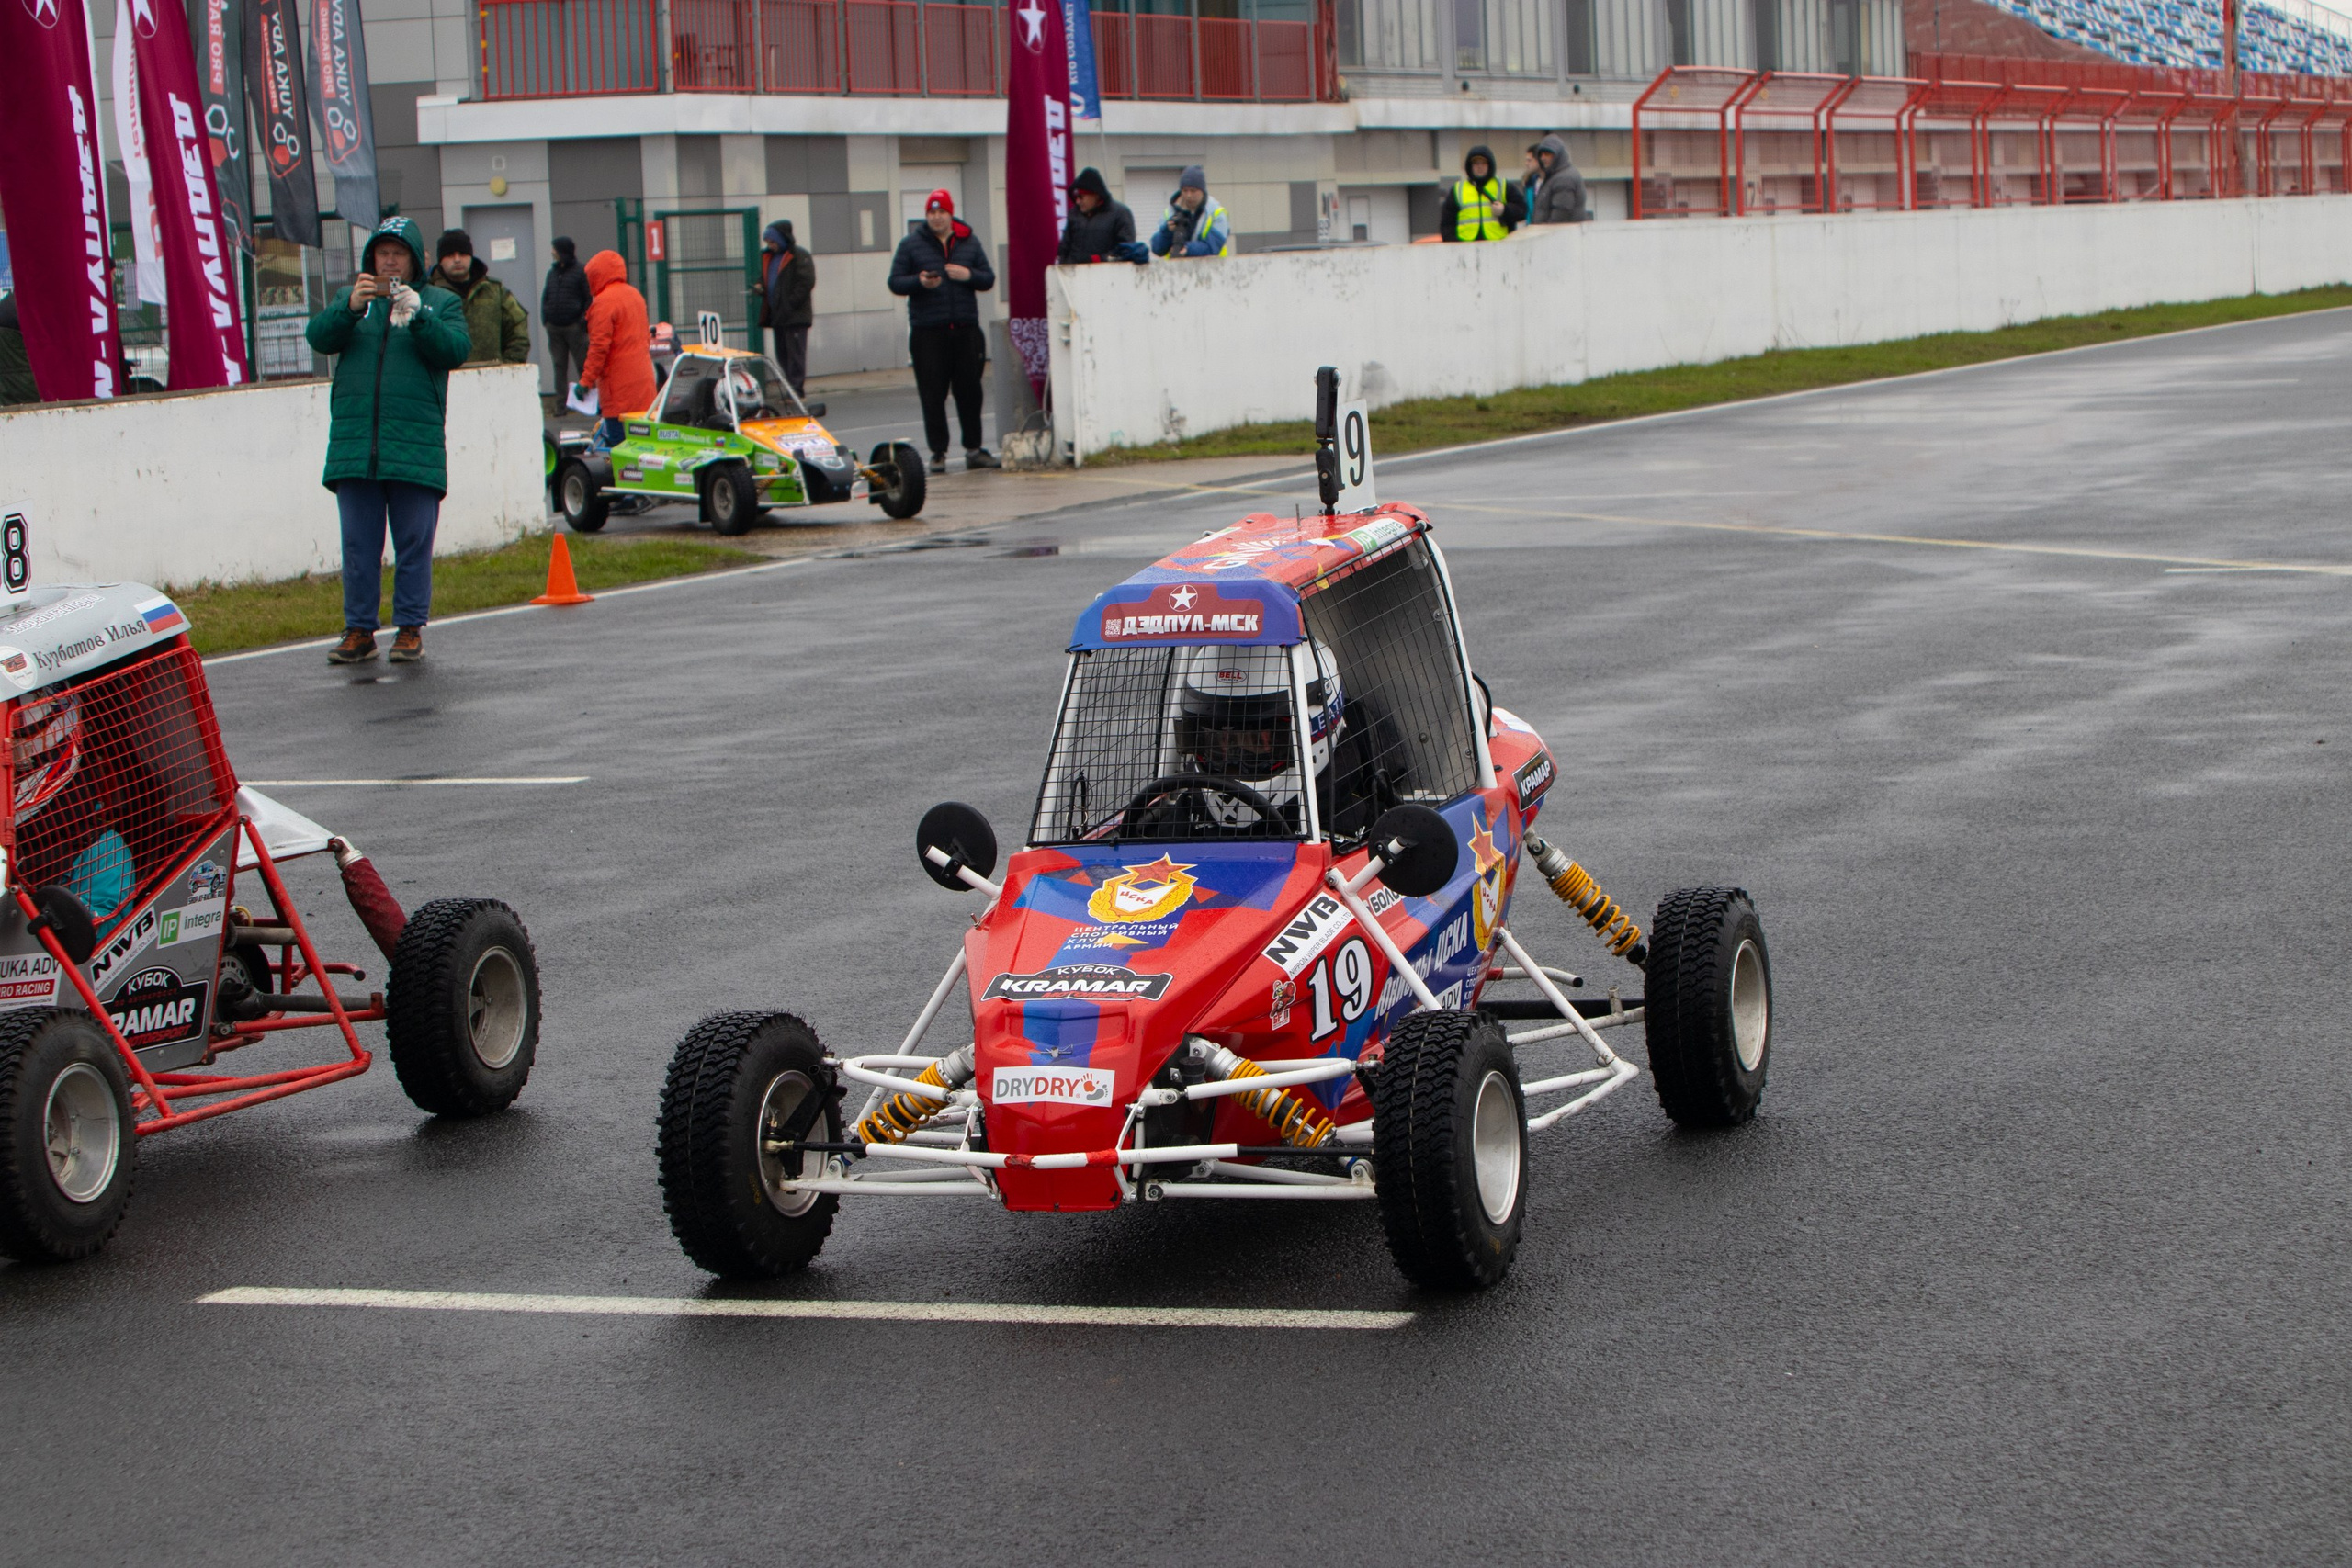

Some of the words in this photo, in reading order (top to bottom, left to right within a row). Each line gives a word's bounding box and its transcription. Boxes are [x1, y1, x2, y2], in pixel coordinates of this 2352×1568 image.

[651, 227, 661, 254] 1
[701, 314, 718, 344] 10
[659, 430, 679, 438] RUSTA
[1372, 520, 1404, 540] integra
[1, 513, 31, 594] 8
[1122, 614, 1259, 636] ДЭДПУЛ-МСК
[33, 635, 106, 671] Курбатов
[105, 619, 147, 643] Илья
[1218, 671, 1243, 680] BELL
[1520, 760, 1551, 797] КРАМАР
[1119, 891, 1154, 905] ЦСКА
[1482, 886, 1497, 913] ЦСКА
[163, 920, 177, 939] IP
[184, 909, 222, 930] integra
[1070, 929, 1168, 938] СПОРТИВНЫЙ
[1073, 922, 1179, 933] ЦЕНТРАЛЬНЫЙ
[1265, 896, 1340, 965] NWB
[92, 910, 155, 983] NWB
[1062, 942, 1114, 951] АРМИИ
[1289, 956, 1308, 976] NIPPON
[1307, 942, 1321, 959] WIPER
[1320, 927, 1336, 944] BLADE
[1434, 911, 1468, 972] ЦСКА
[0, 959, 28, 978] UKA
[30, 956, 60, 976] ADV
[1057, 964, 1120, 976] КУБОК
[0, 986, 14, 998] RO
[16, 981, 51, 996] RACING
[128, 970, 172, 996] КУБОК
[1000, 978, 1152, 993] KRAMAR
[1041, 990, 1142, 998] MOTORSPORT
[1306, 935, 1374, 1045] 19
[109, 998, 196, 1037] RAMAR
[995, 1077, 1080, 1099] DRYDRY
